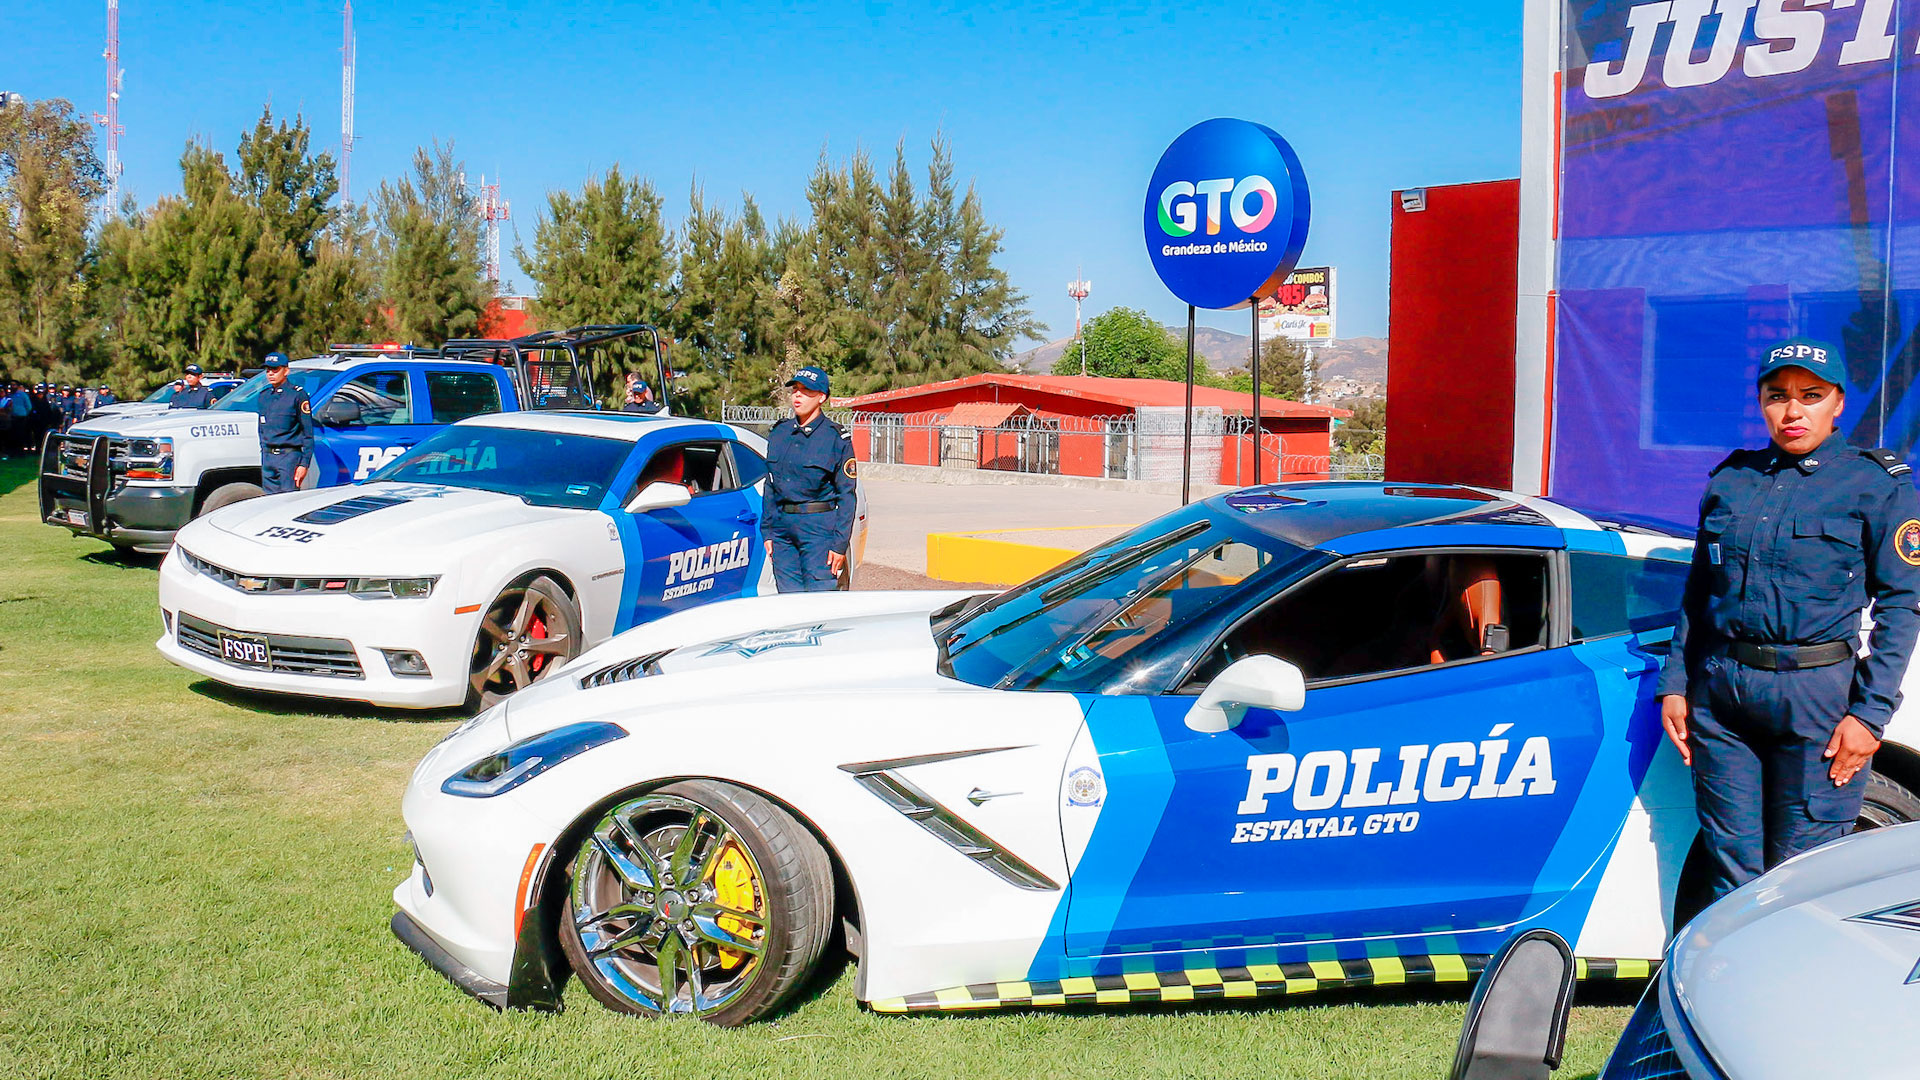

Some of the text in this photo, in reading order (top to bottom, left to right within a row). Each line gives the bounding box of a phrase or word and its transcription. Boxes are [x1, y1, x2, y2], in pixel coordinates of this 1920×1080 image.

[1583, 0, 1920, 98] JUST
[1157, 174, 1277, 237] GTO
[1162, 239, 1268, 256] Grandeza de México
[1293, 272, 1325, 284] COMBOS
[1769, 345, 1827, 363] FSPE
[190, 424, 240, 438] GT425A1
[255, 526, 325, 543] FSPE
[665, 531, 750, 586] POLICÍA
[661, 577, 715, 602] ESTATAL GTO
[223, 638, 268, 663] FSPE
[1237, 722, 1557, 815] POLICÍA
[1230, 811, 1420, 844] ESTATAL GTO
